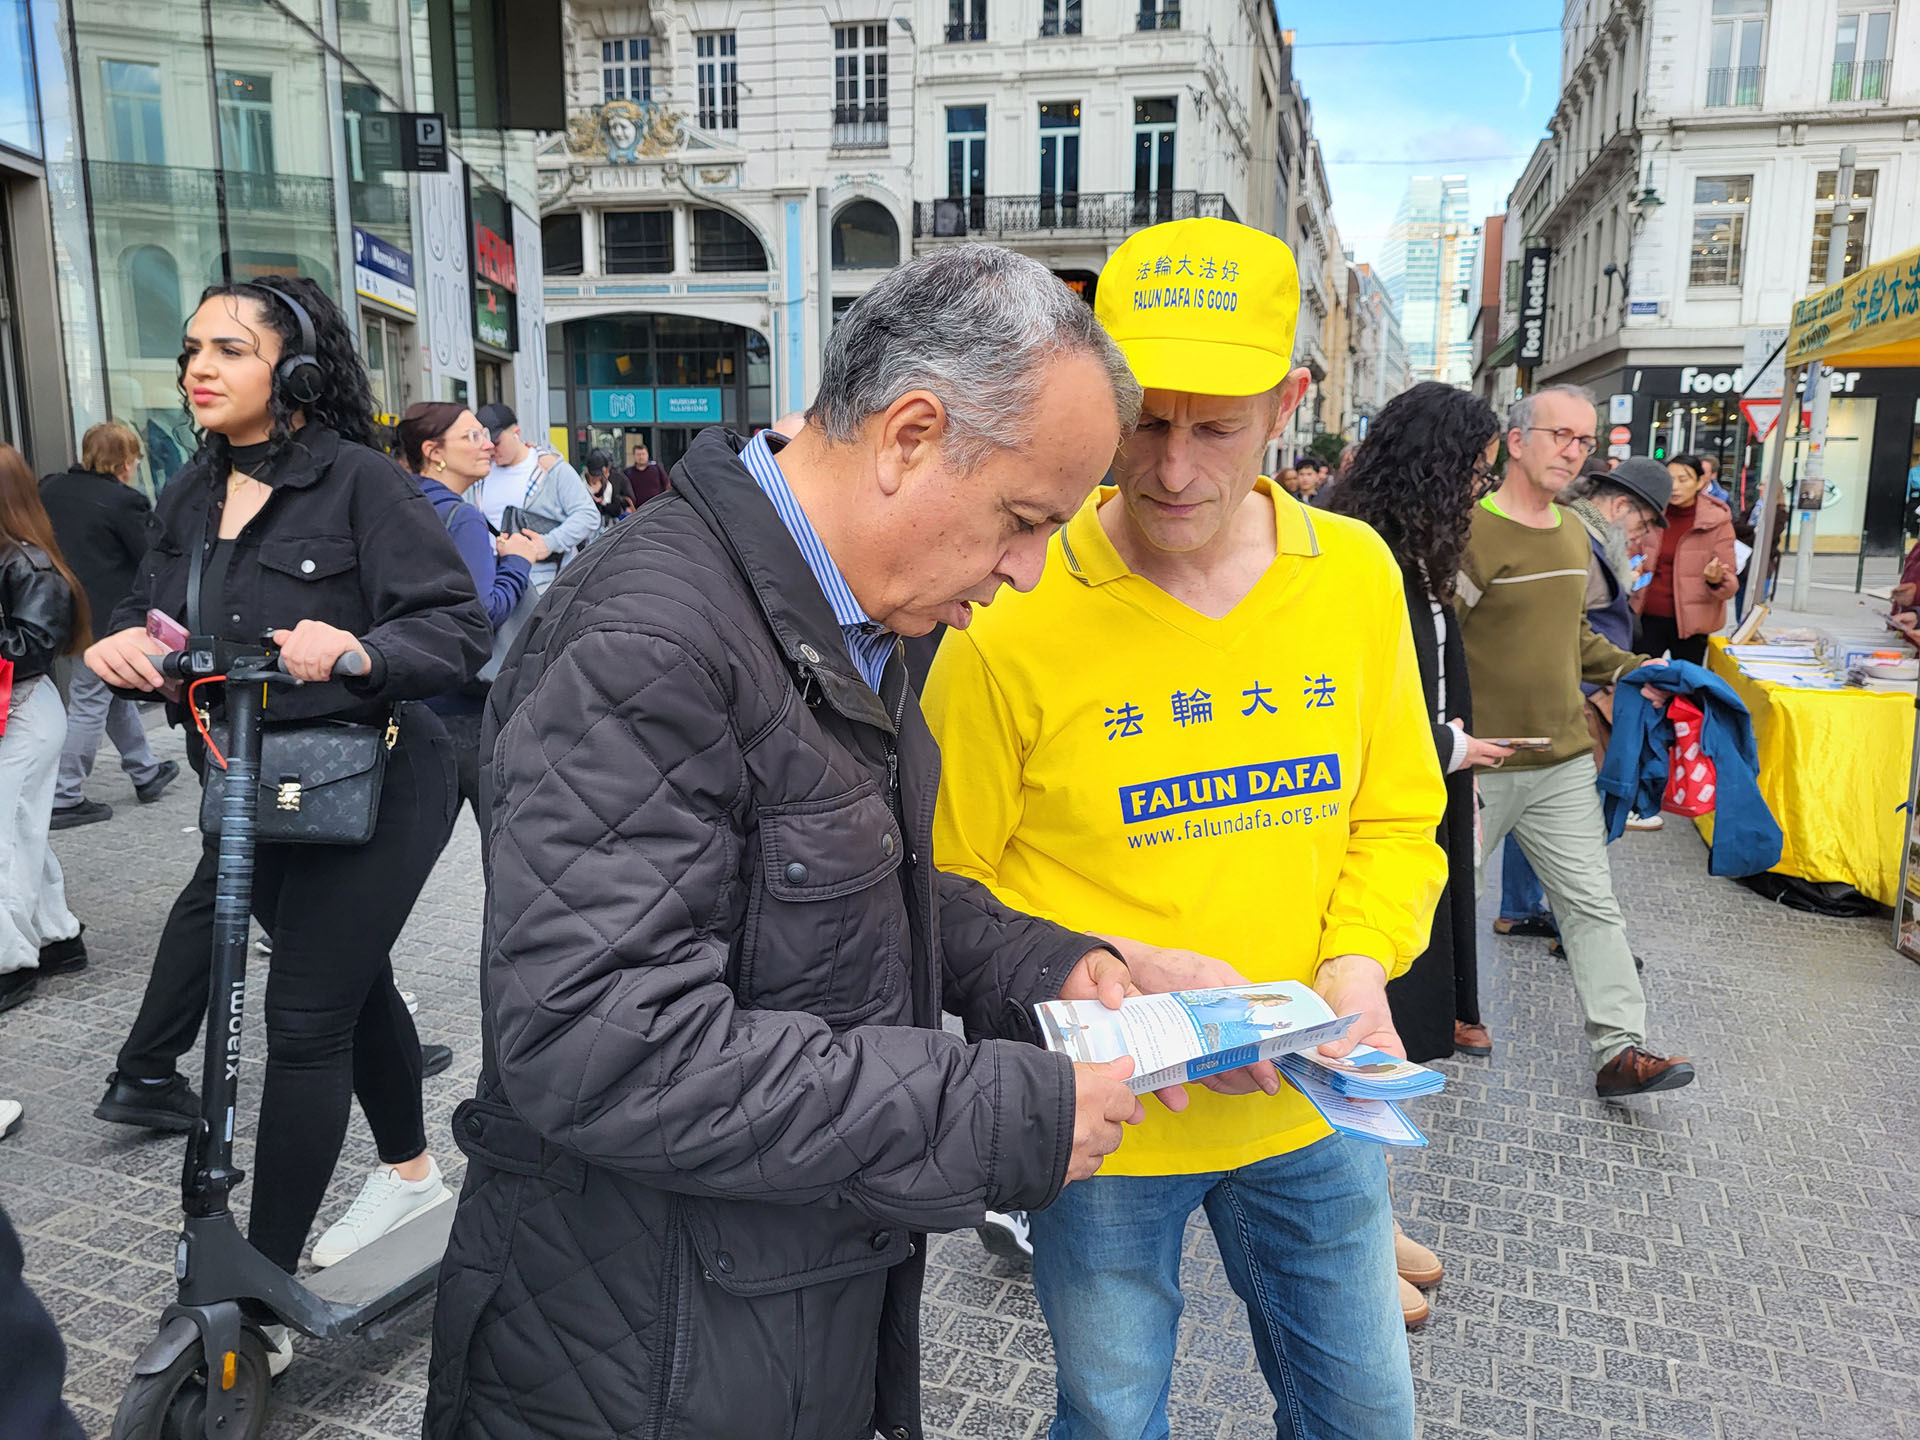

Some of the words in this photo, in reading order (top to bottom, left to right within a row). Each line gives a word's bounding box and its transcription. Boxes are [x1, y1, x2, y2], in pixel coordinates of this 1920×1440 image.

[423, 123, 435, 141] P
[355, 231, 364, 262] P
[1136, 254, 1240, 282] 法輪大法好
[1133, 288, 1163, 312] FALUN
[1164, 287, 1191, 308] DAFA
[1193, 288, 1205, 308] IS
[1207, 289, 1238, 312] GOOD
[1524, 256, 1547, 316] Locker
[1521, 318, 1542, 358] Foot
[1680, 367, 1744, 394] Foot
[1104, 673, 1337, 741] 法輪大法
[1130, 774, 1238, 817] FALUN
[1247, 761, 1334, 796] DAFA
[1127, 801, 1341, 849] www.falundafa.org.tw
